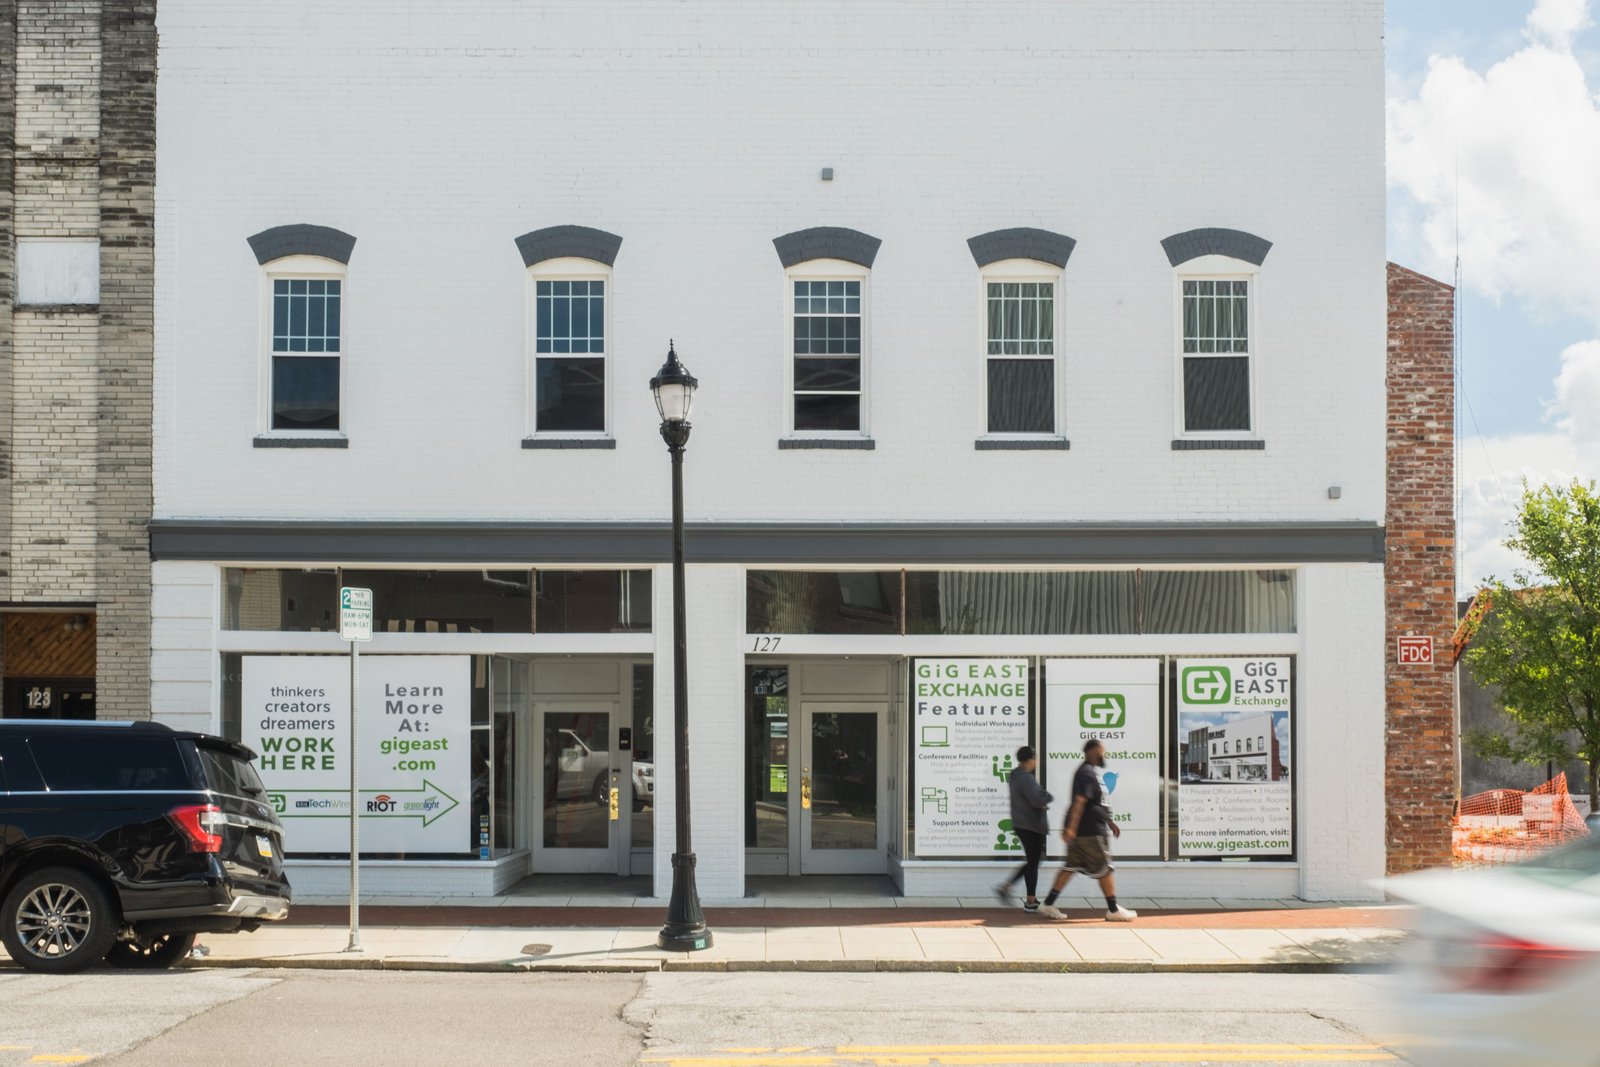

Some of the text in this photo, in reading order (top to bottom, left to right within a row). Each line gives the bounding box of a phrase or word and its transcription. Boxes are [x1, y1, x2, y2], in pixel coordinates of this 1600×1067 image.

[344, 592, 351, 606] 2
[343, 621, 369, 629] MON-SAT
[752, 636, 781, 652] 127
[1400, 645, 1430, 662] FDC
[968, 664, 1027, 679] EAST
[270, 686, 326, 698] thinkers
[384, 683, 444, 697] Learn
[917, 682, 1026, 697] EXCHANGE
[1234, 678, 1289, 694] EAST
[26, 690, 52, 706] 123
[1234, 695, 1289, 708] Exchange
[264, 701, 331, 714] creators
[385, 700, 444, 715] More
[917, 701, 1026, 716] Features
[260, 716, 336, 731] dreamers
[398, 718, 430, 733] At:
[989, 720, 1025, 729] Workspace
[1099, 731, 1126, 740] EAST
[260, 737, 336, 753] WORK
[380, 736, 449, 755] gigeast
[1049, 749, 1157, 760] www.east.com
[260, 755, 336, 770] HERE
[392, 758, 436, 771] .com
[932, 819, 989, 828] Support Services
[1180, 829, 1194, 837] For
[1219, 828, 1269, 837] information,
[1269, 828, 1290, 836] visit:
[1181, 838, 1290, 852] www.gigeast.com
